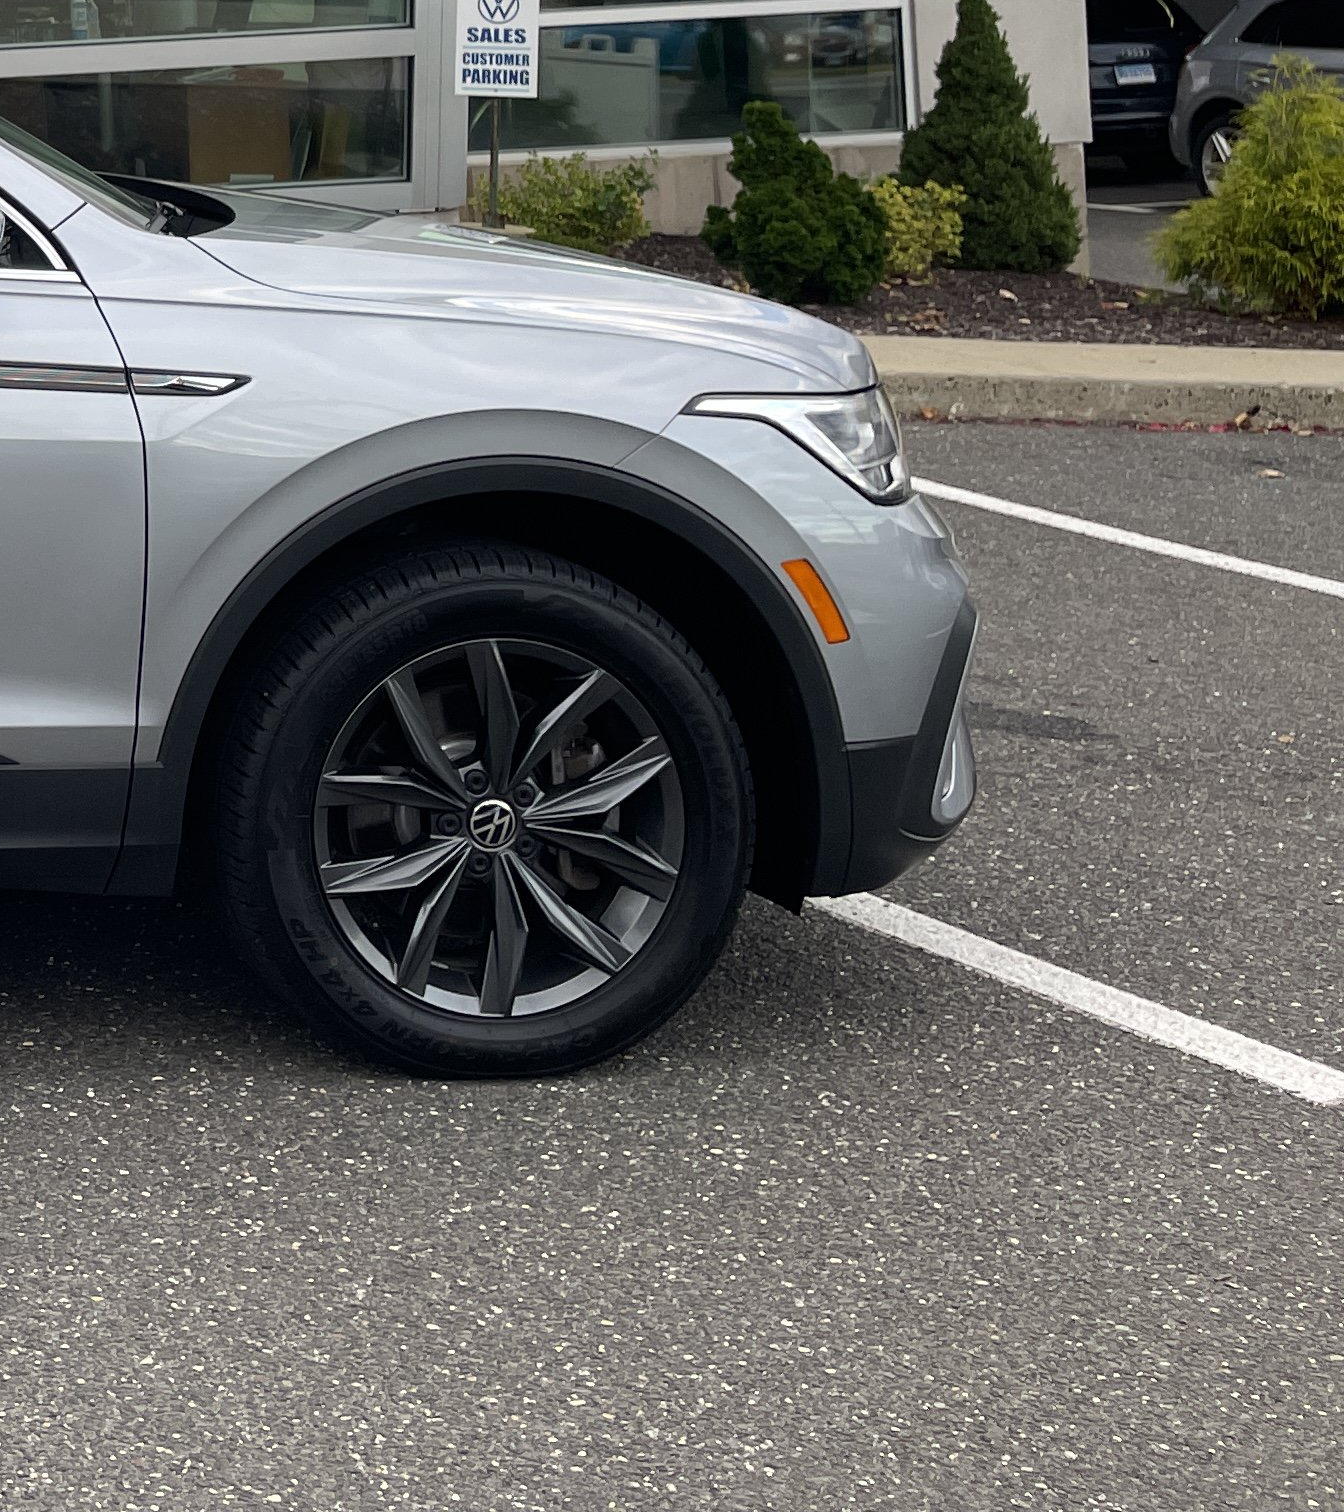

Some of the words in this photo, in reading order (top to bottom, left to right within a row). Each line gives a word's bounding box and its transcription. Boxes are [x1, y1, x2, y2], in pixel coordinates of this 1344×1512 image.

[467, 27, 526, 44] SALES
[462, 52, 530, 67] CUSTOMER
[462, 68, 530, 86] PARKING
